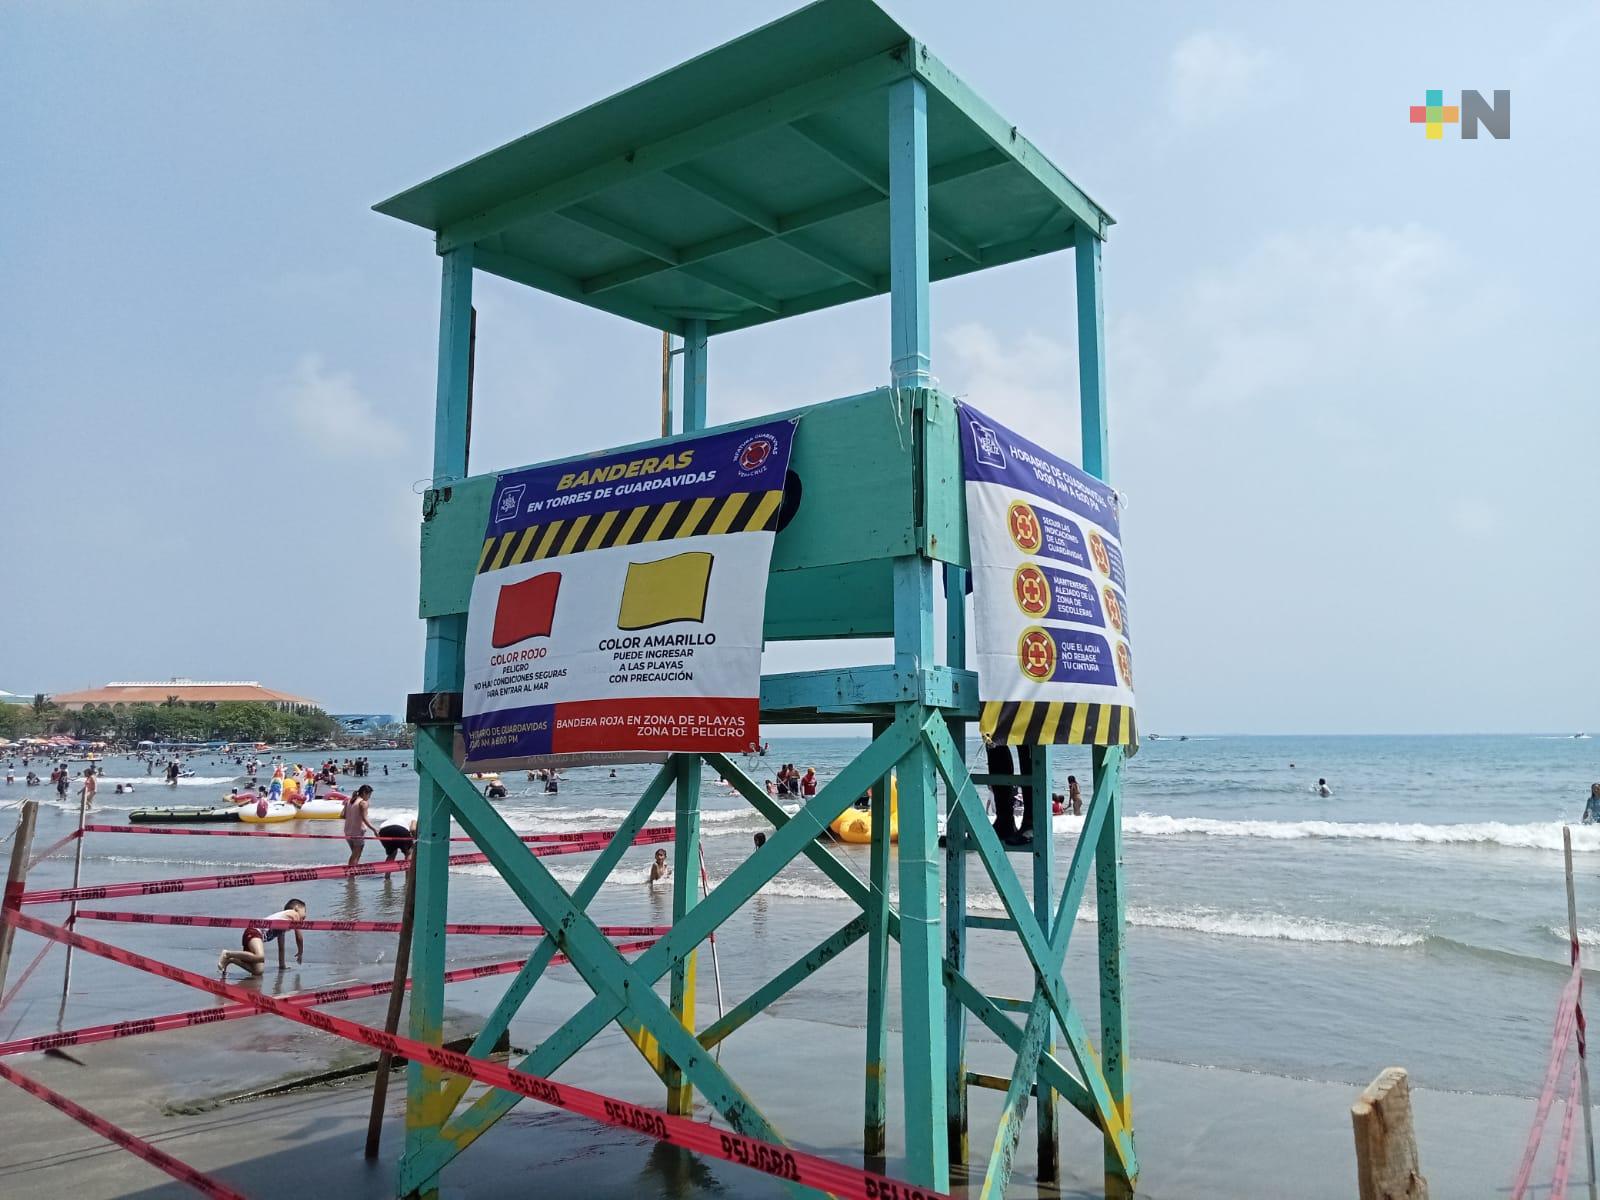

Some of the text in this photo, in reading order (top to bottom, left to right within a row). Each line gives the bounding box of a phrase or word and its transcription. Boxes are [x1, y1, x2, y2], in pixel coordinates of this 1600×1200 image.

[1009, 445, 1051, 473] HORARIO
[1051, 465, 1063, 479] DE
[556, 450, 695, 491] BANDERAS
[527, 502, 544, 513] EN
[546, 490, 592, 509] TORRES
[594, 487, 614, 500] DE
[615, 470, 717, 496] GUARDAVIDAS
[1056, 480, 1070, 494] AM
[1042, 516, 1070, 533] SEGUIR LAS
[1044, 525, 1079, 545] INDICACIONES
[1046, 535, 1065, 547] DE LOS
[1053, 576, 1089, 593] MANTENERSE
[1055, 586, 1096, 602] ALEJADO DE LA
[1056, 595, 1082, 608] ZONA DE
[1057, 603, 1093, 618] ESCOLLERAS
[598, 633, 716, 651] COLOR AMARILLO
[1061, 641, 1100, 654] QUE EL AGUA
[490, 647, 547, 666] COLOR ROJO
[613, 648, 694, 660] PUEDE INGRESAR
[1062, 652, 1097, 663] NO REBASE
[502, 662, 529, 675] PELIGRO
[619, 660, 684, 672] A LAS PLAYAS
[1062, 660, 1100, 672] TU CINTURA
[493, 673, 534, 686] CONDICIONES
[535, 668, 568, 680] SEGURAS
[609, 670, 693, 684] CON PRECAUCIÓN
[500, 685, 523, 696] ENTRAR
[523, 683, 532, 692] AL
[533, 682, 549, 691] MAR
[491, 727, 500, 736] DE
[501, 721, 548, 735] GUARDAVIDAS
[556, 715, 745, 729] BANDERA ROJA EN ZONA DE PLAYAS
[508, 734, 519, 744] PM
[637, 726, 745, 738] ZONA DE PELIGRO
[142, 881, 185, 895] PELIGRO
[315, 989, 349, 1005] PELIGRO
[187, 1008, 226, 1026] PELIGRO
[113, 1019, 156, 1038] PELIGRO
[32, 1031, 78, 1051] PELIGRO
